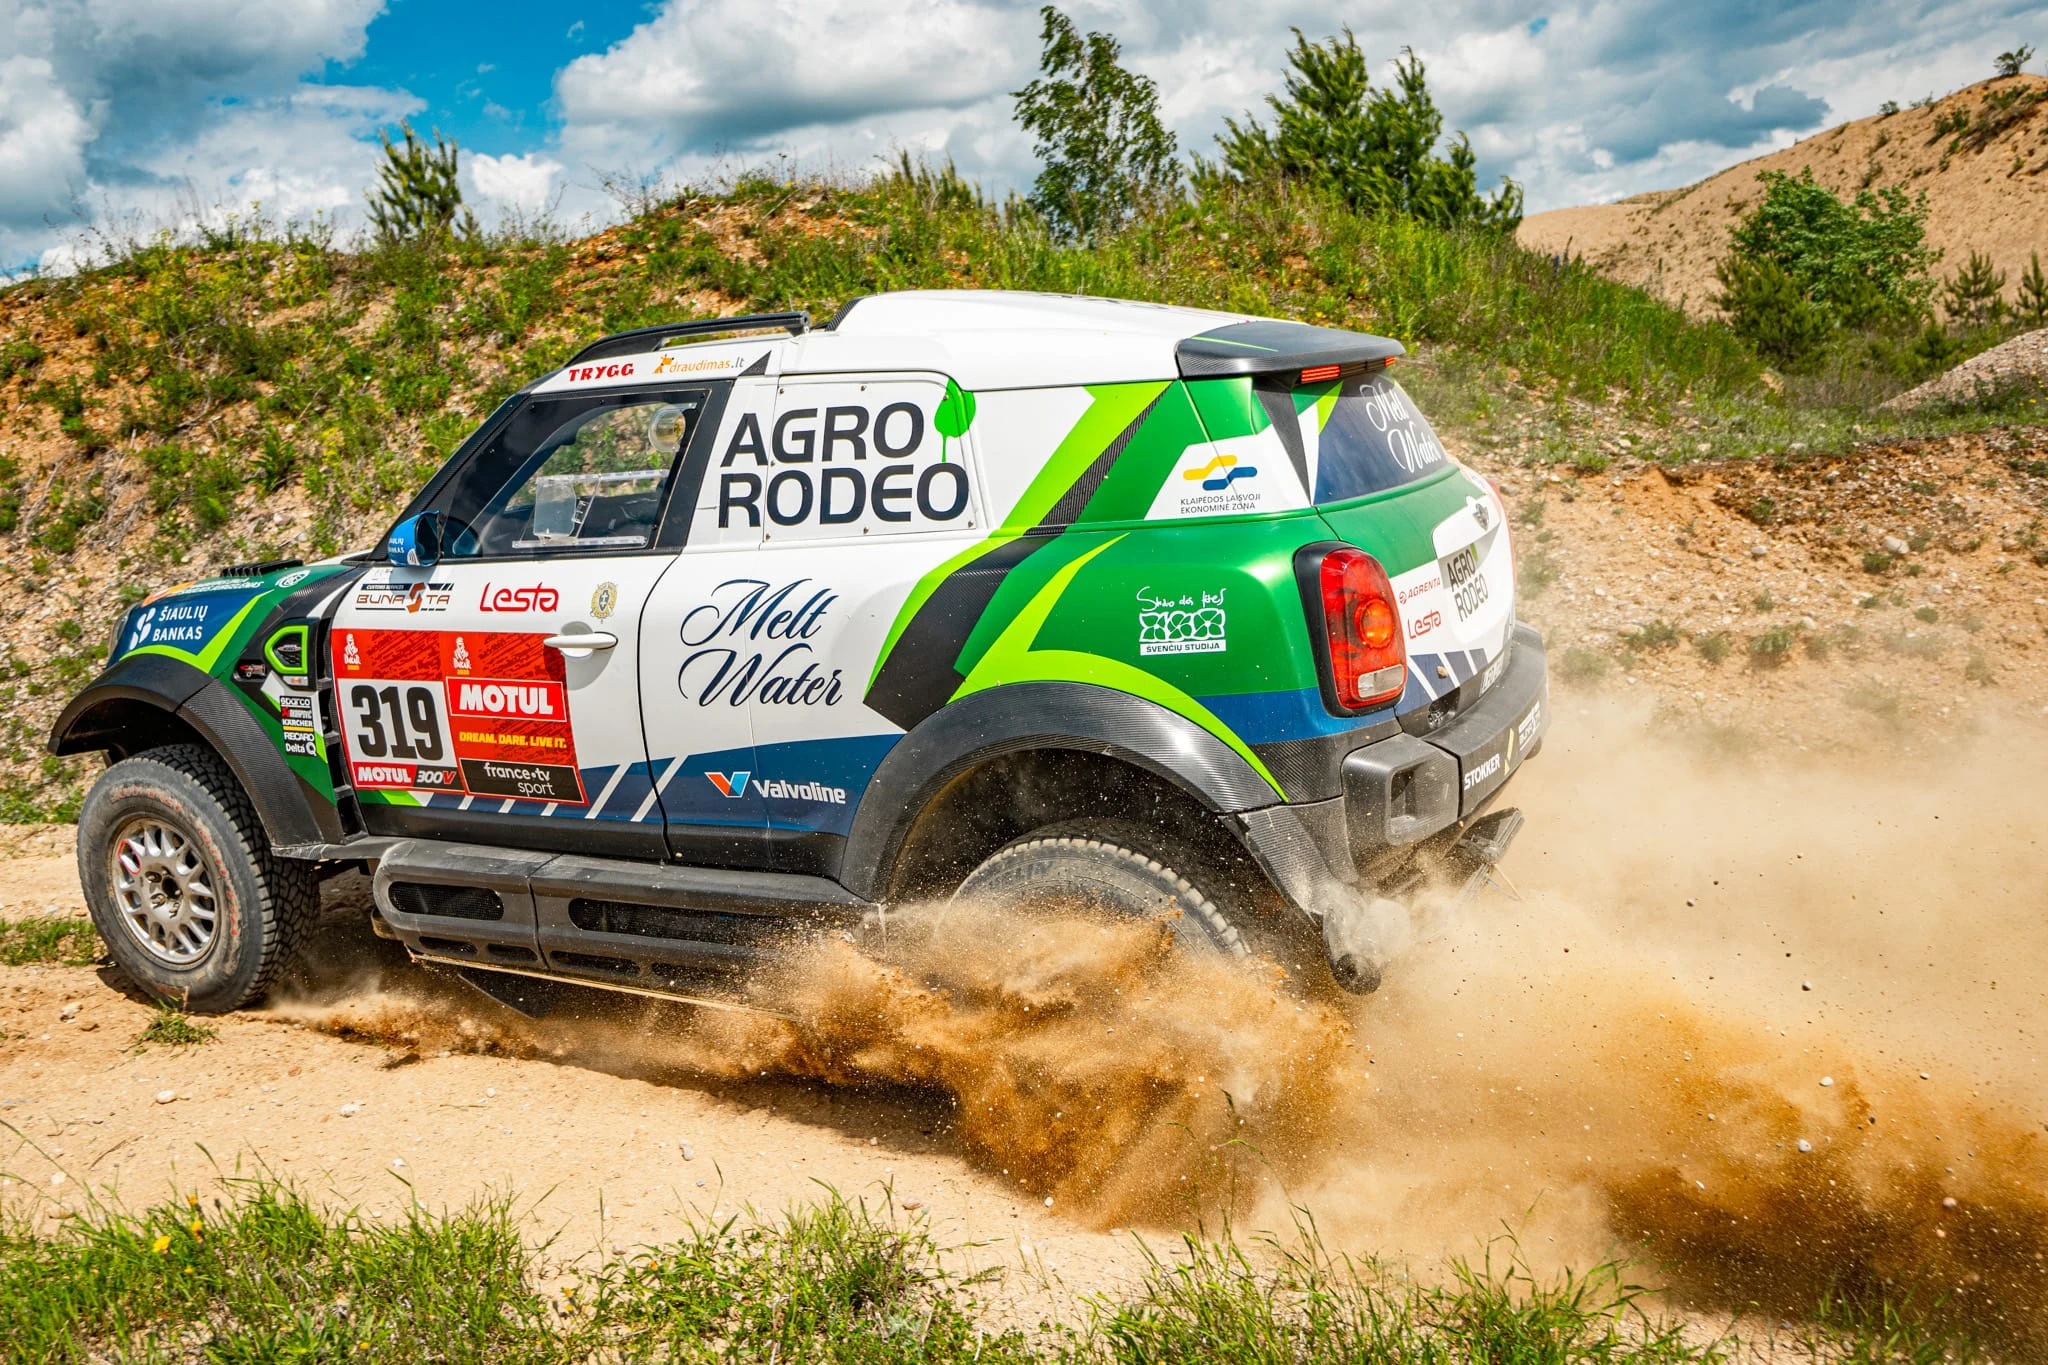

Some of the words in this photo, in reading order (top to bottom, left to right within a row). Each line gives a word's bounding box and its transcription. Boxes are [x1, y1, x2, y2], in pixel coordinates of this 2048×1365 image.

[568, 363, 635, 382] TRYGG
[668, 356, 745, 374] draudimas.lt
[719, 401, 925, 468] AGRO
[718, 461, 969, 529] RODEO
[1446, 548, 1476, 592] AGRO
[479, 580, 560, 613] Lesta
[1407, 577, 1441, 599] AGRENTA
[1454, 573, 1489, 622] RODEO
[158, 604, 209, 622] ŠIAULIŲ
[680, 578, 839, 647] Melt
[1407, 609, 1442, 640] Lesta
[151, 626, 204, 642] BANKAS
[1185, 642, 1220, 651] STUDIJA
[678, 642, 843, 708] Water
[458, 684, 554, 715] MOTUL
[284, 732, 315, 741] RECARO
[350, 684, 444, 761] 319
[458, 731, 497, 745] DREAM.
[498, 733, 529, 746] DARE.
[529, 735, 552, 748] LIVE
[552, 737, 568, 749] IT.
[357, 766, 412, 784] MOTUL
[416, 769, 456, 785] 300V
[1463, 753, 1501, 791] STOKKER
[517, 781, 556, 797] sport
[752, 779, 847, 804] Valvoline
